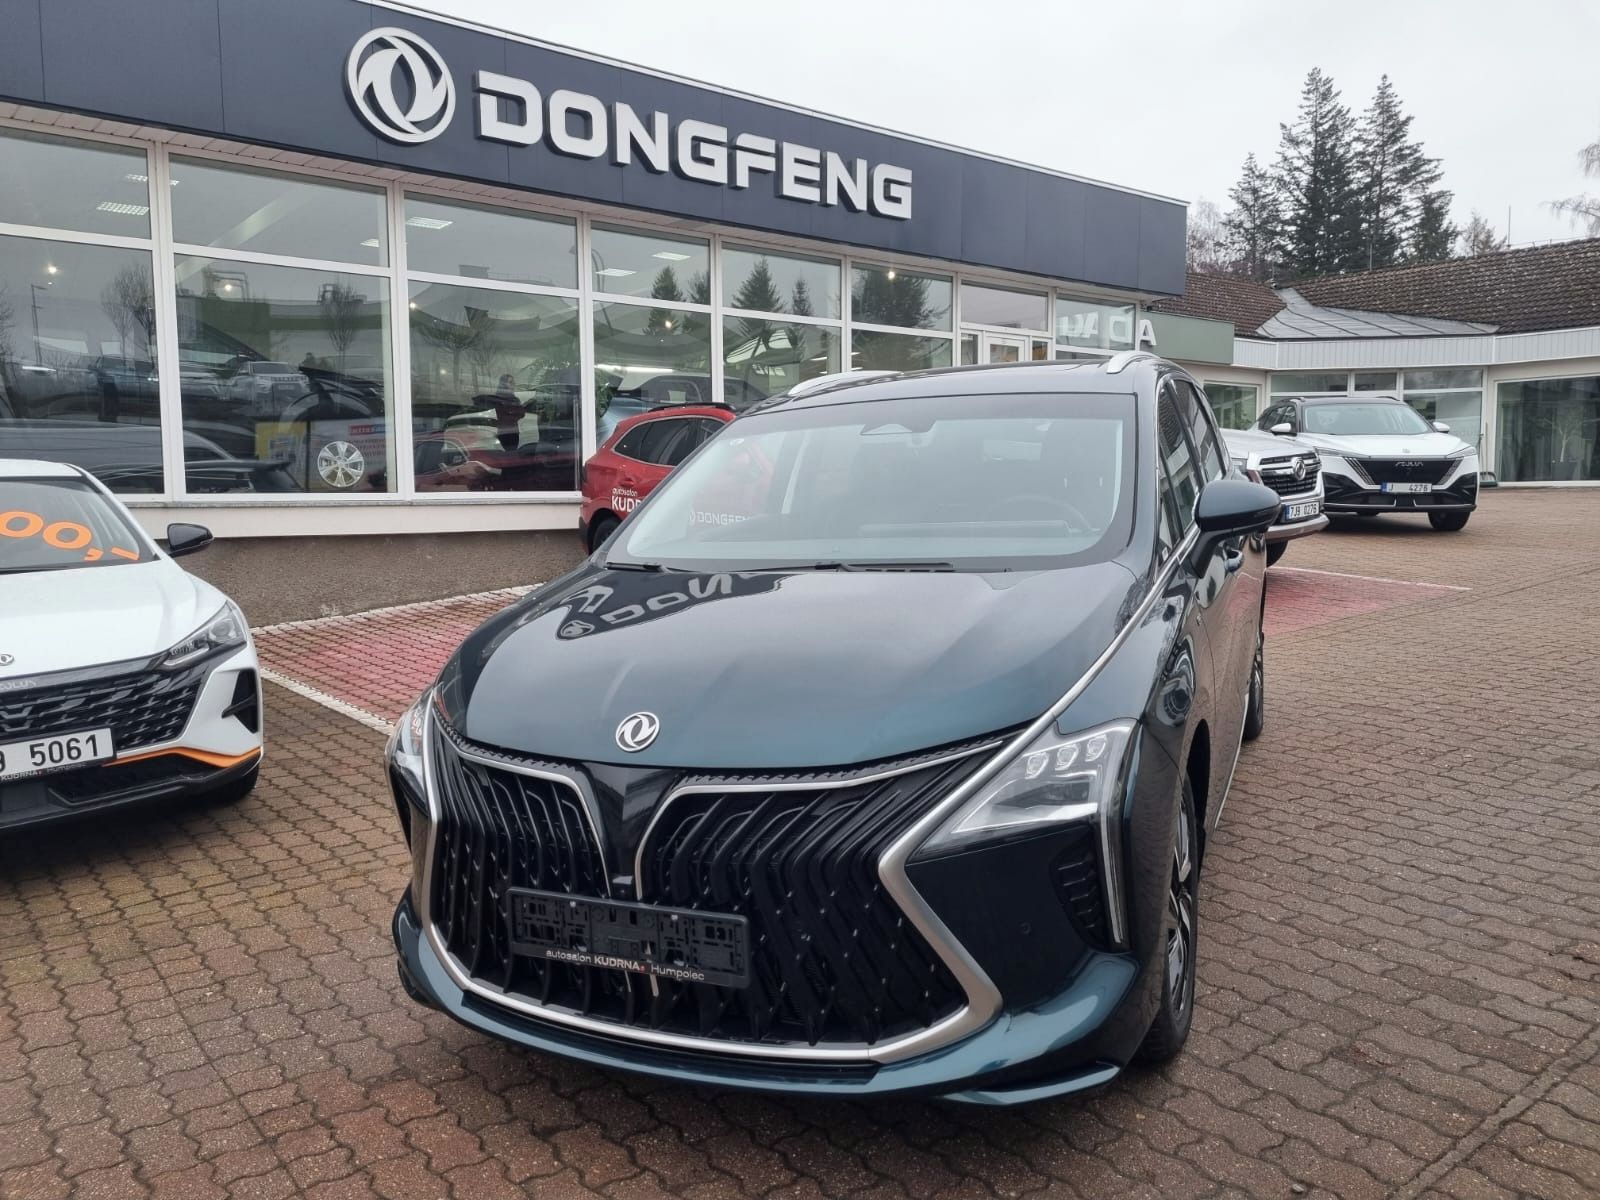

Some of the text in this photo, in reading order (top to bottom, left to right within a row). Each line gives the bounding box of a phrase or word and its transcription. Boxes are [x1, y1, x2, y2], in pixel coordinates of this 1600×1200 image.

[476, 70, 913, 220] DONGFENG
[30, 733, 98, 767] 5061
[546, 948, 705, 981] autosalon KUDRNA Humpolec
